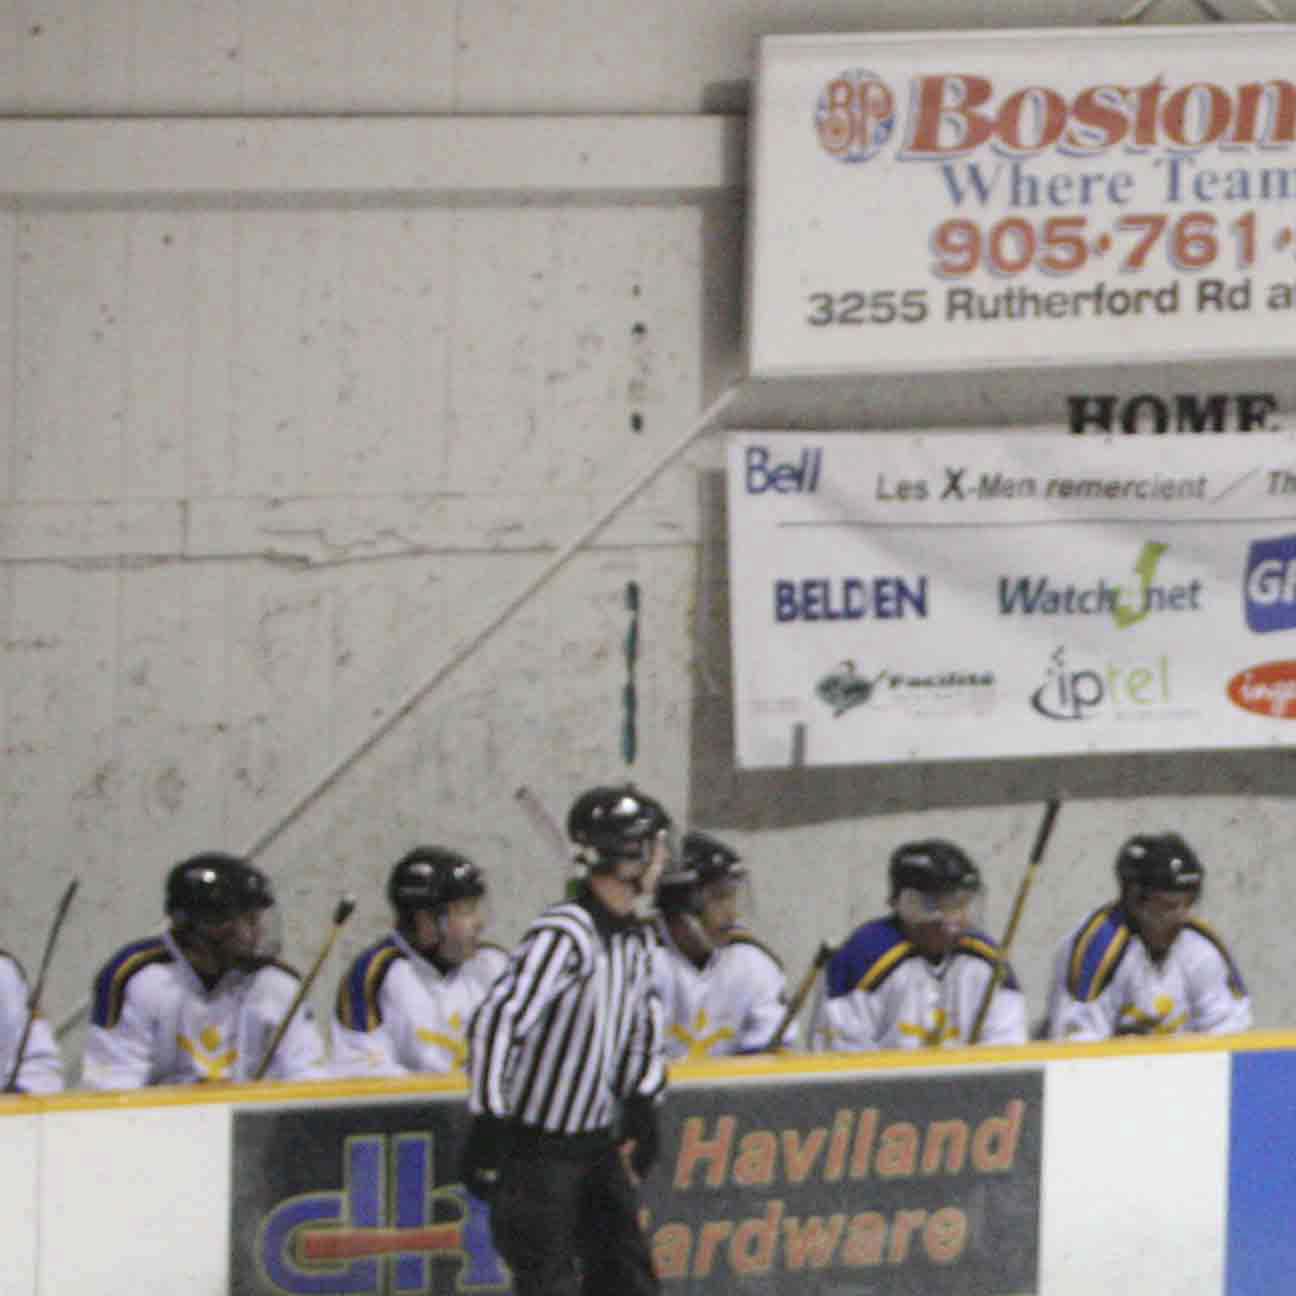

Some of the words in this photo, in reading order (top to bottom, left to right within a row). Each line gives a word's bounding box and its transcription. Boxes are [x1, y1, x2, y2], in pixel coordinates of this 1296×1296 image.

[941, 160, 1134, 208] Where
[807, 290, 928, 327] 3255
[946, 281, 1177, 323] Rutherford
[1200, 278, 1251, 314] Rd
[1067, 393, 1281, 434] HOME
[744, 445, 823, 495] Bell
[876, 474, 929, 500] Les
[939, 466, 1036, 500] X-Men
[1045, 475, 1208, 500] remercient
[774, 576, 928, 624] BELDEN
[673, 1098, 1026, 1189] Haviland
[638, 1202, 968, 1280] ardware
